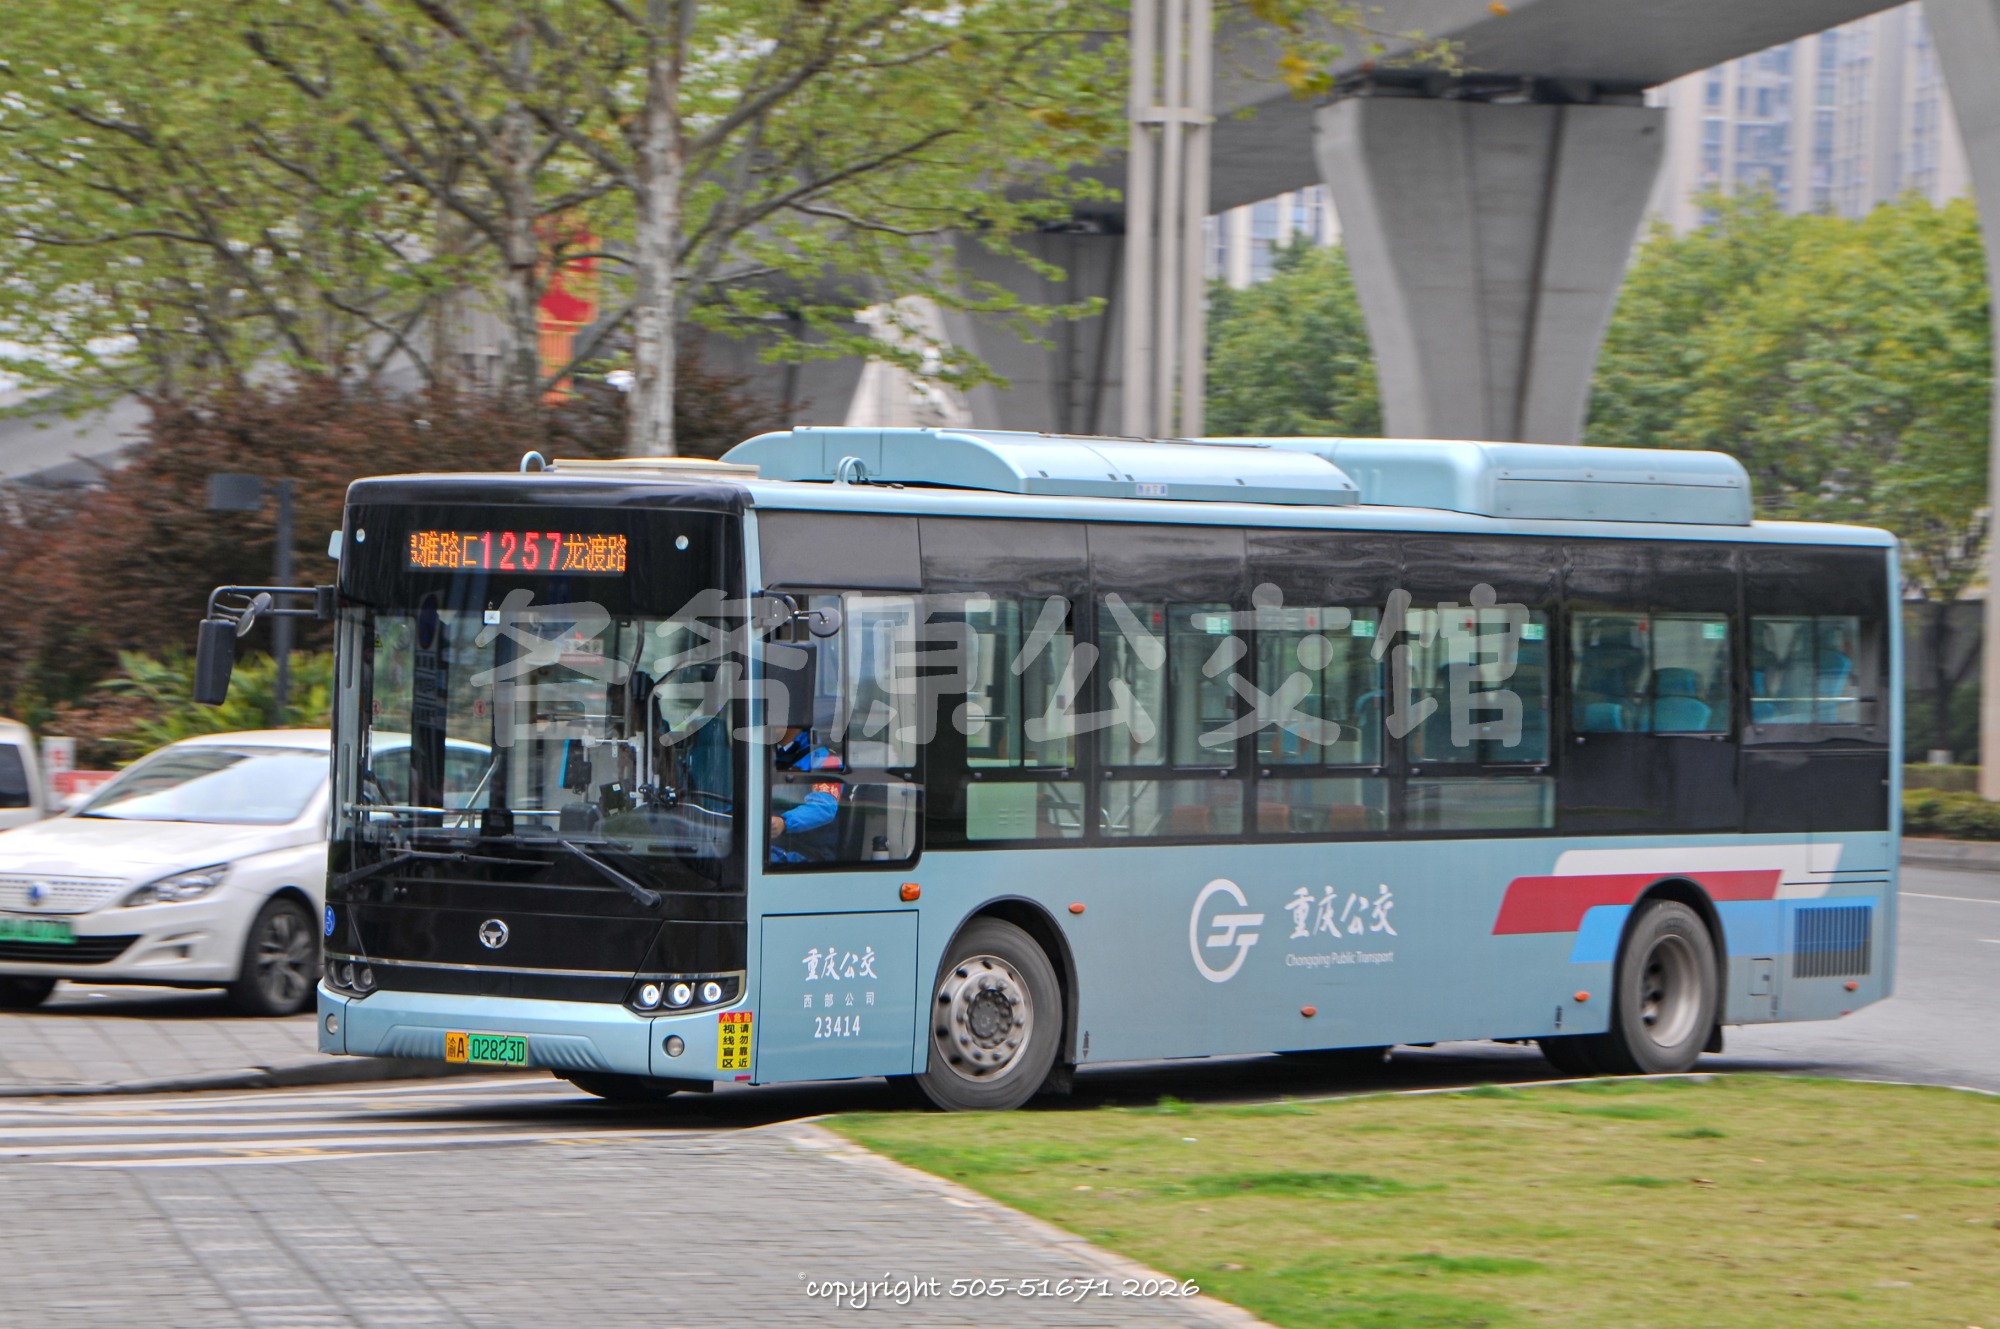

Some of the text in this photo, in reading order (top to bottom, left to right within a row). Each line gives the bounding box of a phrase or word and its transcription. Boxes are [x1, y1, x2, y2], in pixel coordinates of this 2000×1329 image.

[480, 531, 563, 570] 1257
[562, 533, 627, 571] 龙渡路
[1284, 883, 1398, 939] 重庆公交
[802, 946, 878, 981] 重庆公交
[814, 1015, 860, 1038] 23414
